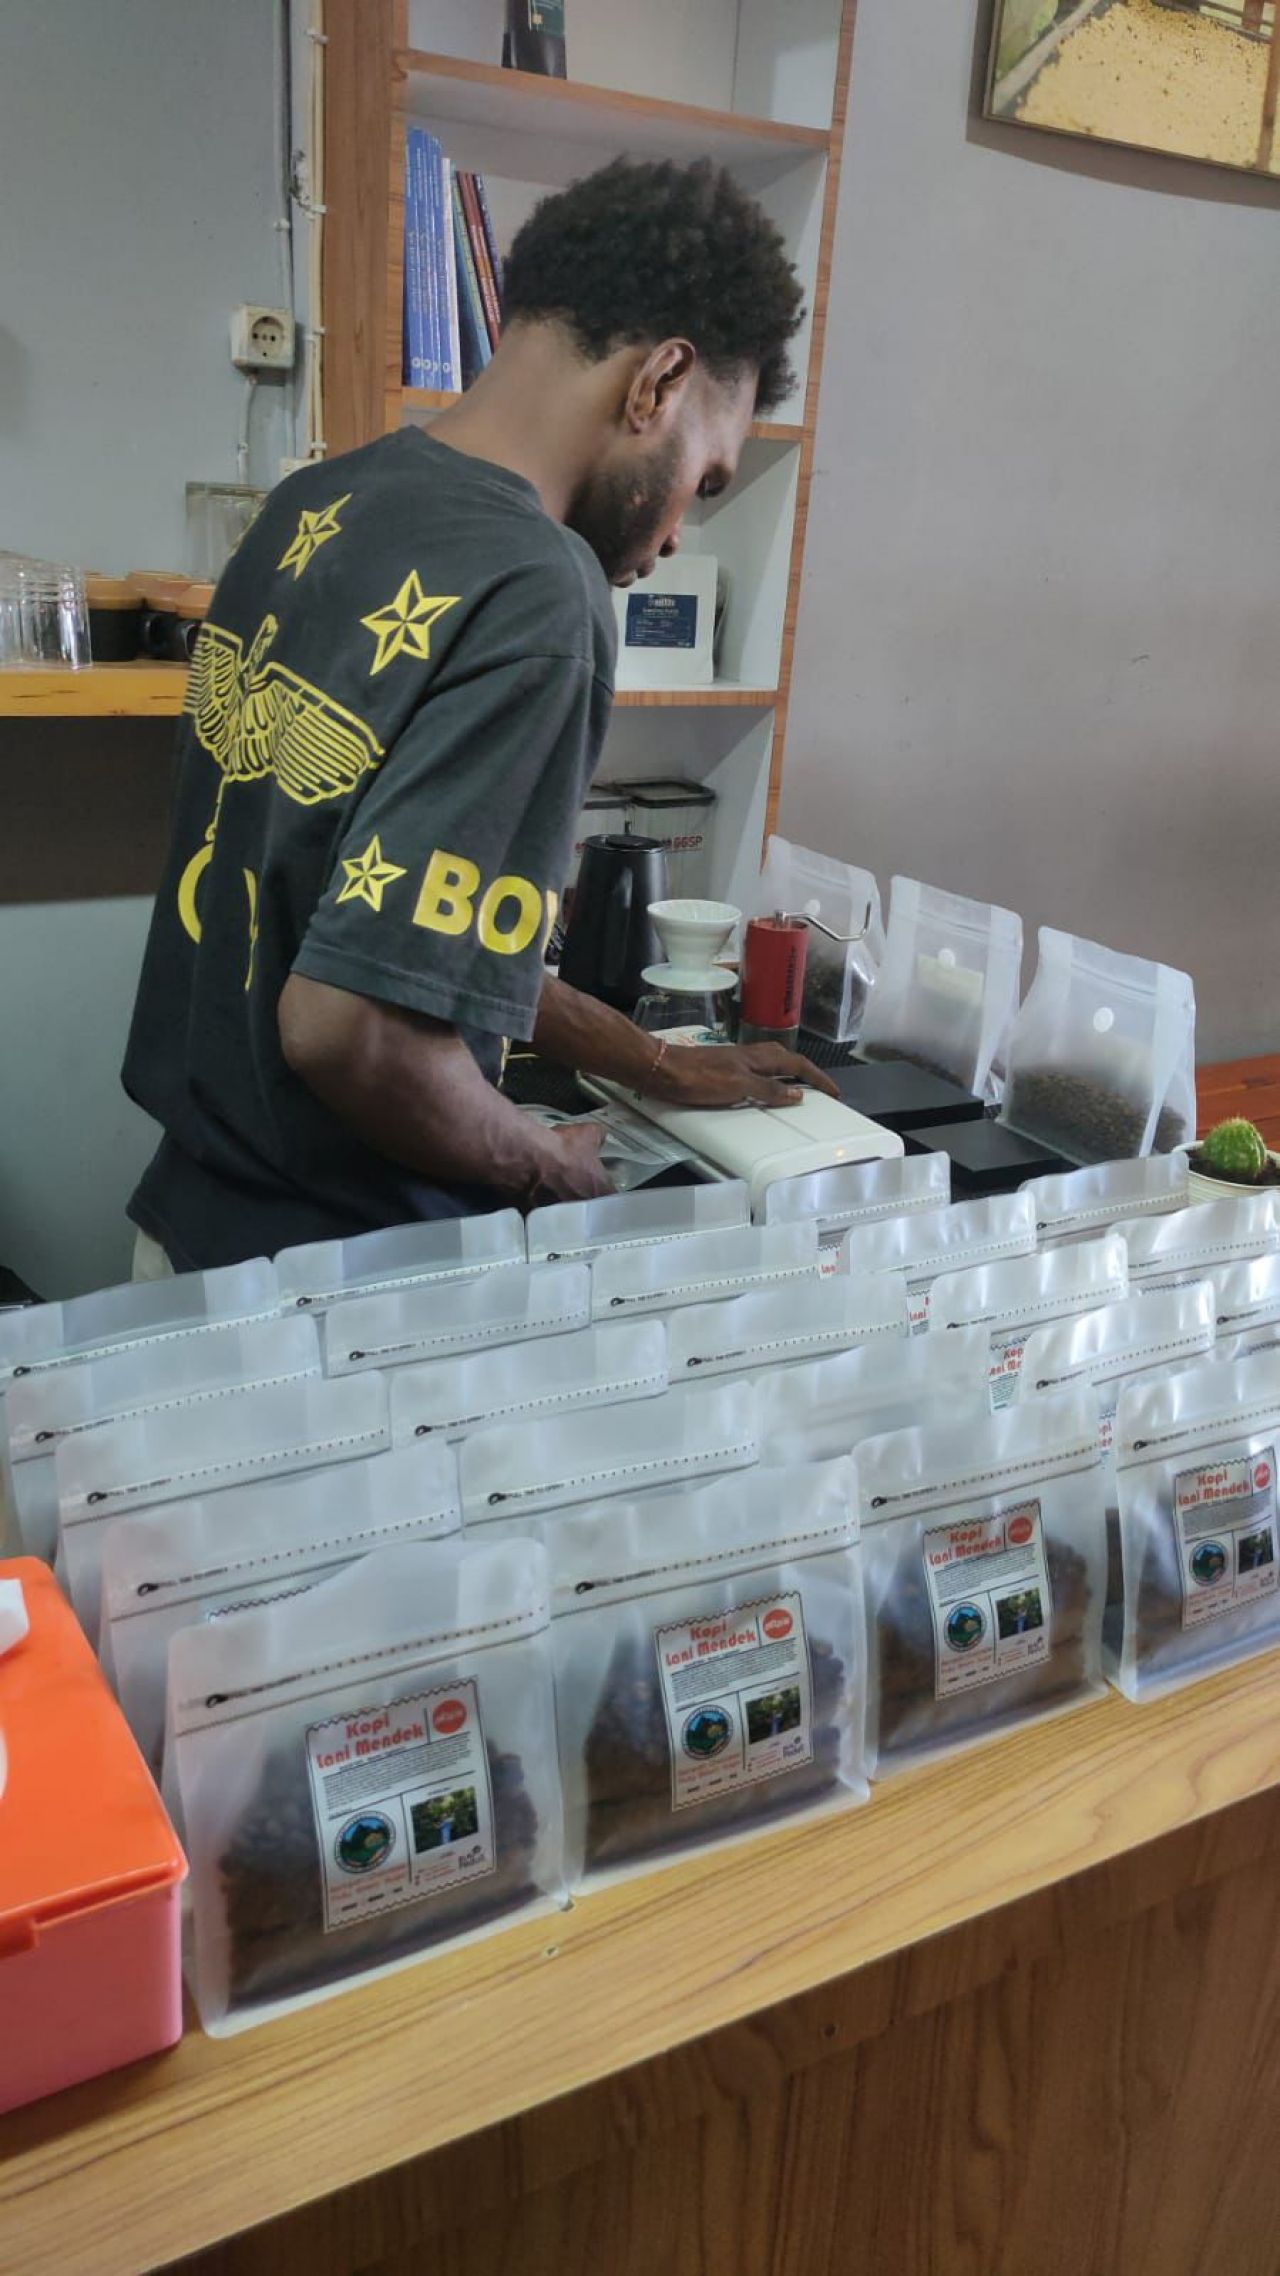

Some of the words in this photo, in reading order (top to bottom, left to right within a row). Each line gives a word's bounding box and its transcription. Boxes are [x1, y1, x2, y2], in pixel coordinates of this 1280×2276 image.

[413, 849, 558, 958] BO
[1197, 1468, 1228, 1486] Kopi
[949, 1525, 983, 1544] Kopi
[689, 1621, 726, 1641] Kopi
[696, 1630, 757, 1657] Mendek
[346, 1713, 391, 1739] Kopi
[355, 1724, 424, 1756] Mendek
